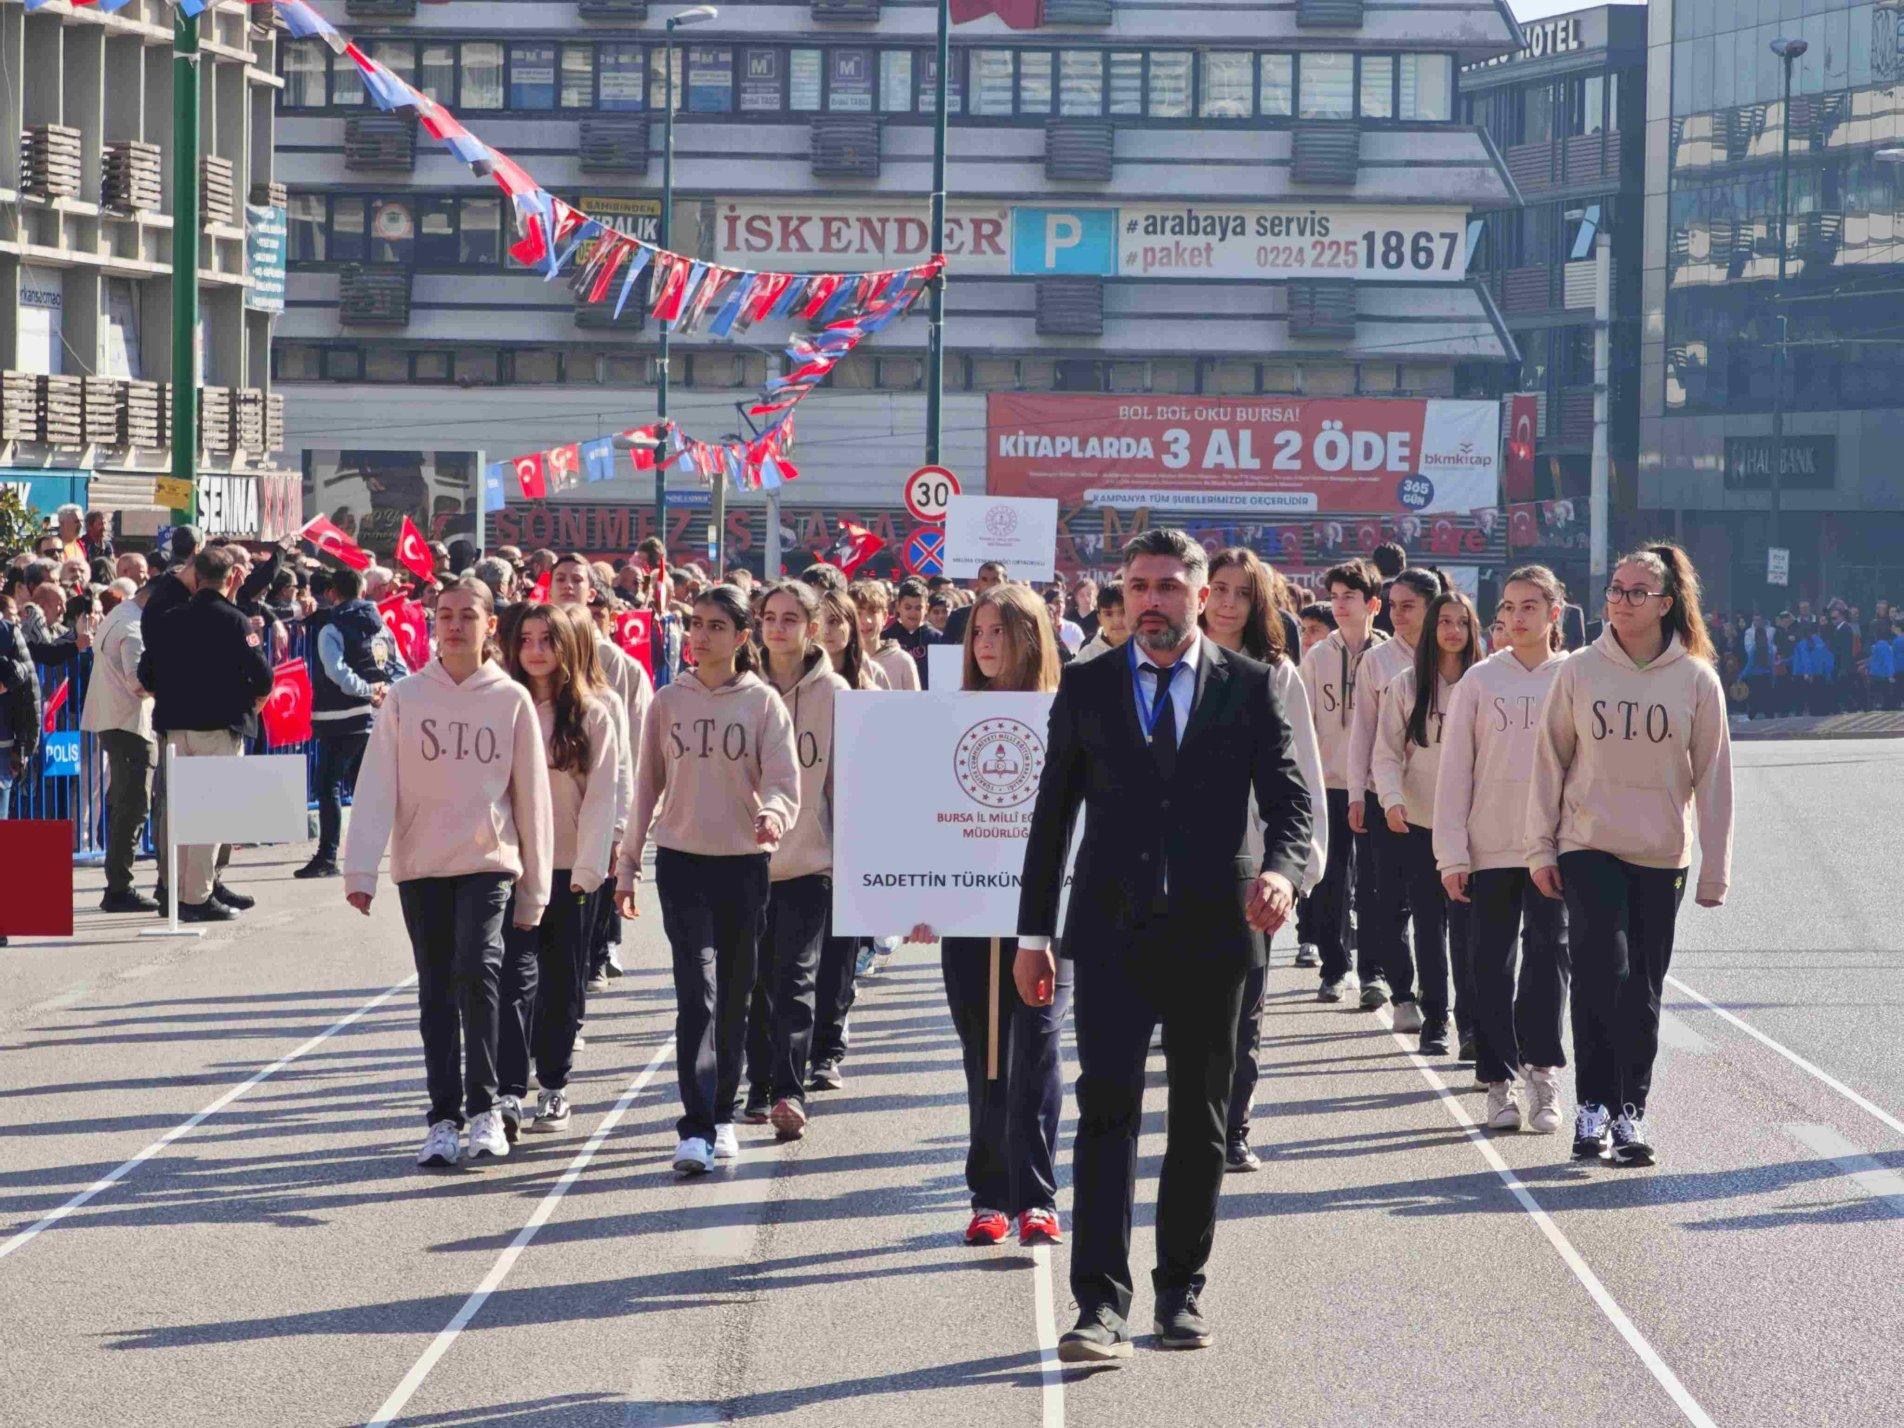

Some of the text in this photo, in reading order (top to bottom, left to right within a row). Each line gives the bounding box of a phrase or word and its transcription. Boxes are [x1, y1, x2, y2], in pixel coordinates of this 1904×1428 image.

[723, 204, 1006, 255] İSKENDER
[1255, 210, 1330, 238] servis
[1045, 213, 1082, 269] P
[1256, 245, 1306, 268] 0224
[1310, 240, 1359, 269] 225
[1362, 230, 1459, 271] 1867
[1119, 406, 1300, 422] BOL BOL OKU BURSA!
[999, 420, 1411, 472] KİTAPLARDA 3 AL 2 ÖDE
[1747, 447, 1817, 475] HALBANK
[916, 482, 949, 508] 30
[1093, 493, 1146, 503] KAMPANYA
[1150, 494, 1170, 504] TÜM
[1402, 479, 1429, 495] 365
[1402, 493, 1425, 506] GÜN
[199, 475, 259, 533] SENNA
[495, 504, 691, 551] SÖNMEZ
[1591, 699, 1673, 744] S.T.O.
[420, 718, 501, 764] S.T.O.
[670, 718, 750, 761] S.T.O.
[937, 812, 974, 823] BURSA
[976, 811, 987, 823] İL
[962, 826, 1030, 839] MÜDÜRLÜĞ
[862, 870, 1022, 888] SADETTİN TÜRKÜN
